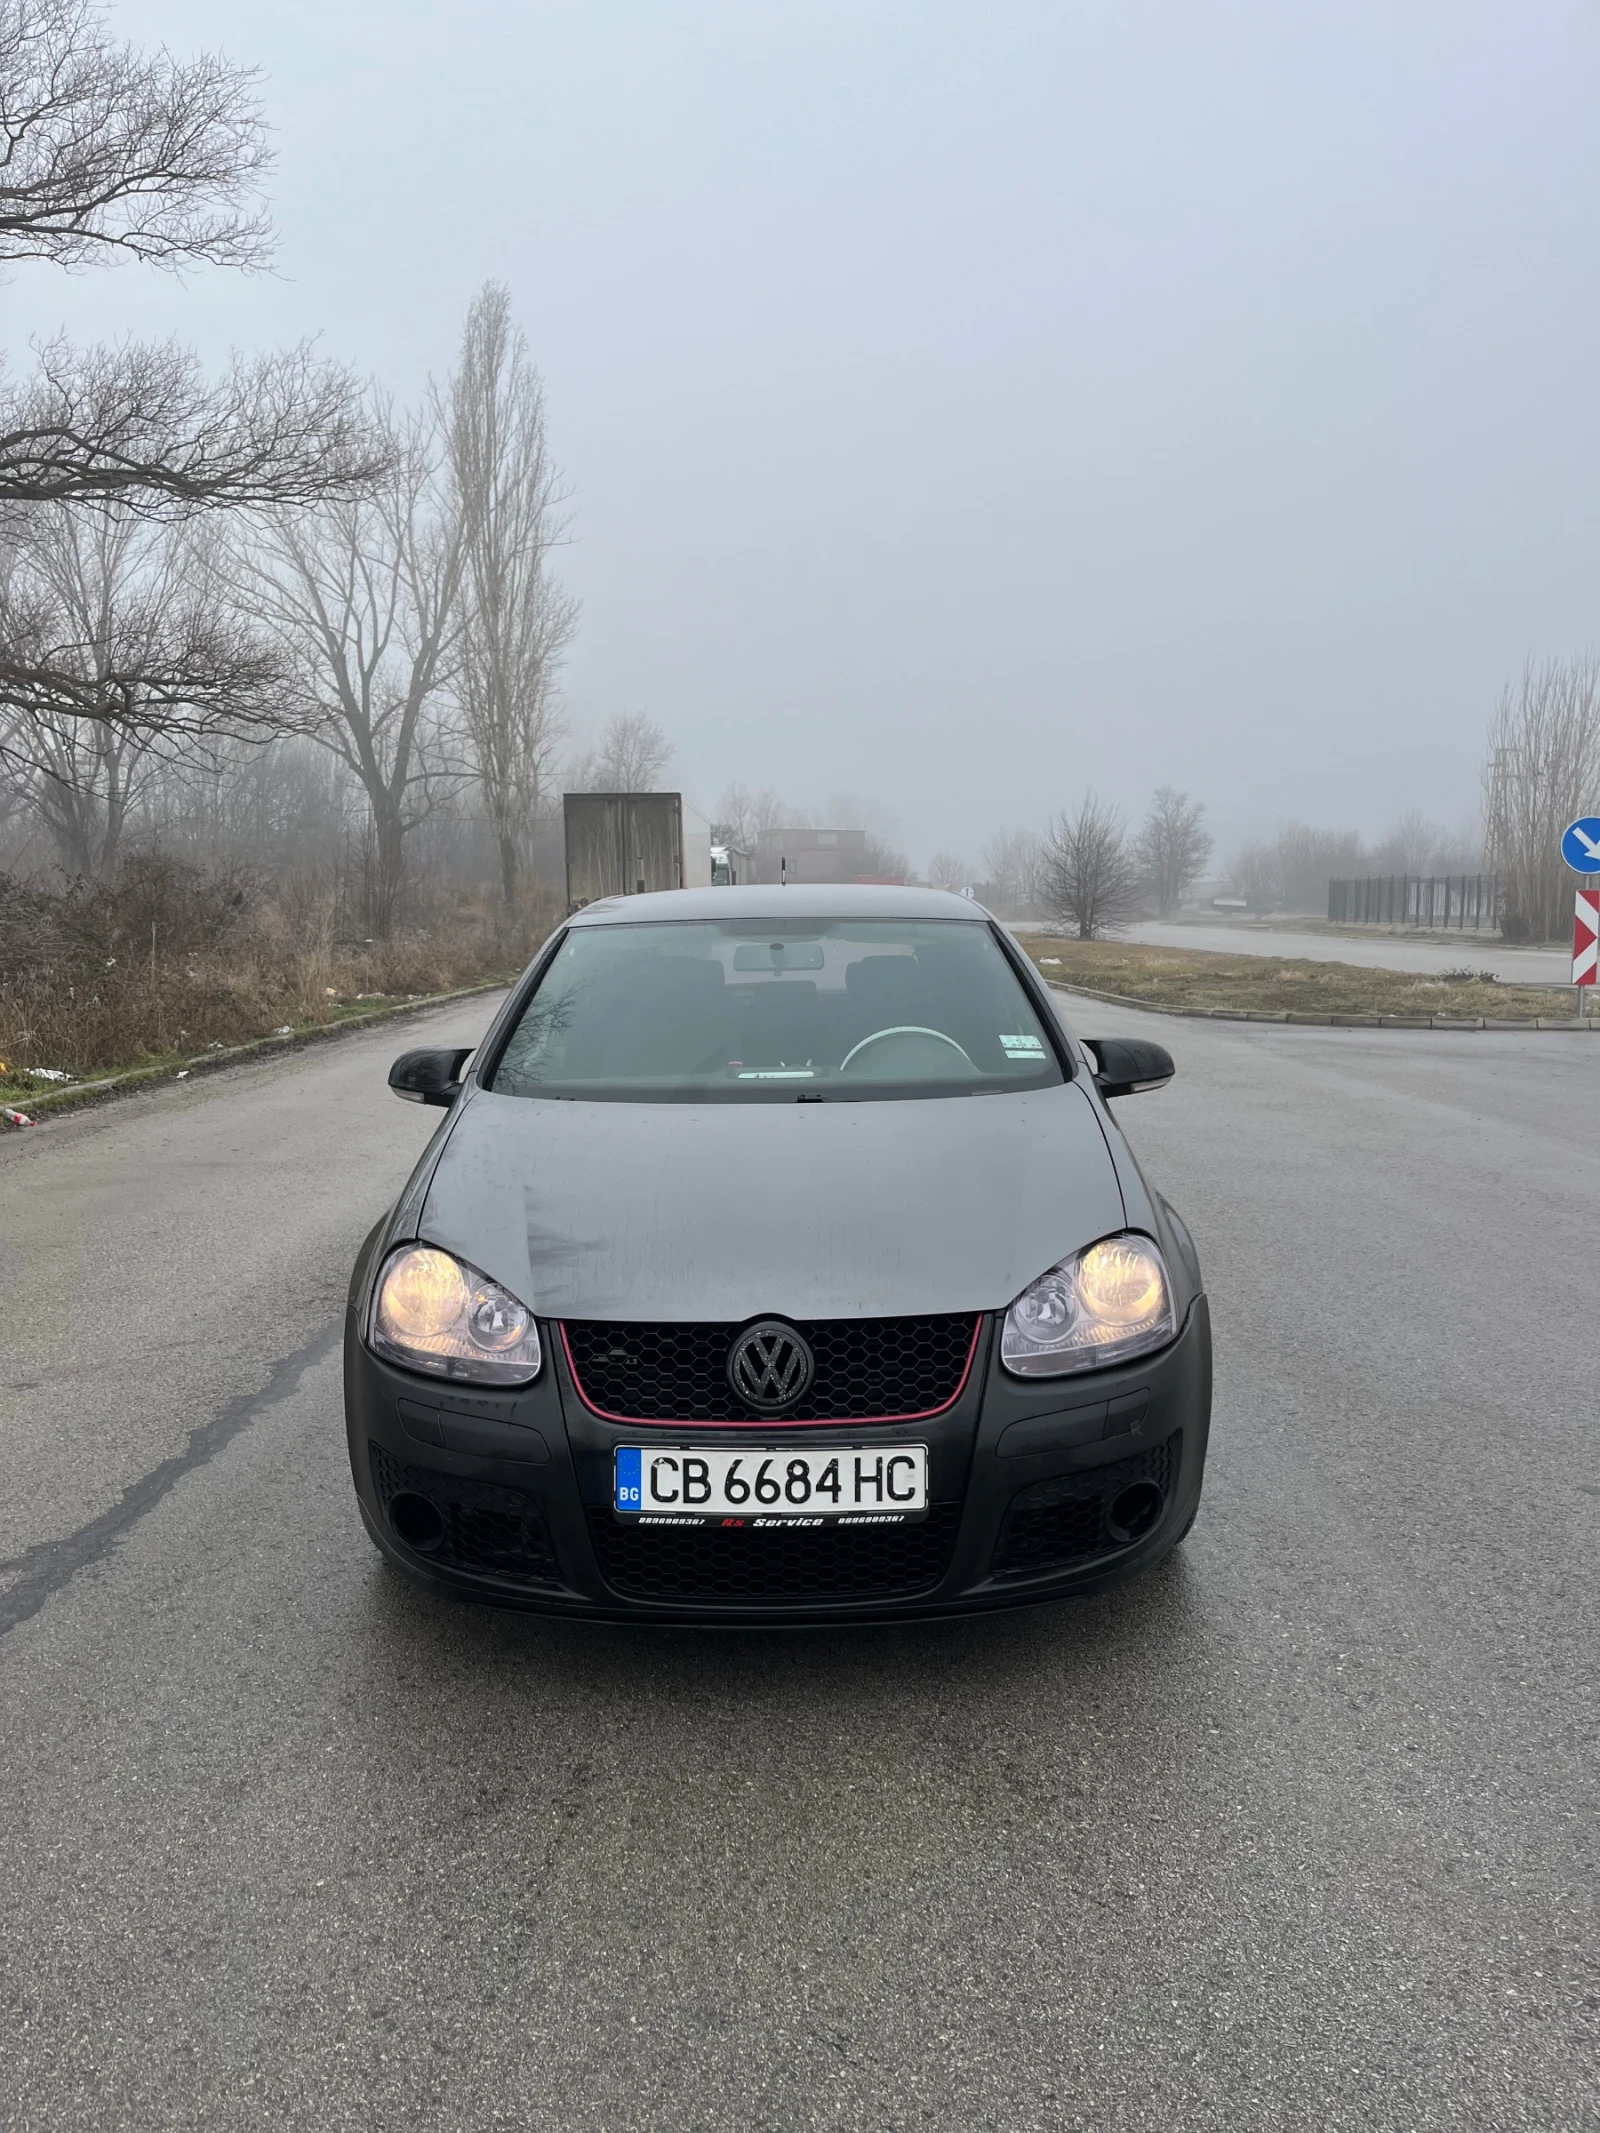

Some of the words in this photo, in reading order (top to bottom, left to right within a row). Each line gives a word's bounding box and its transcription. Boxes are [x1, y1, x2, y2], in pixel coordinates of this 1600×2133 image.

[650, 1456, 712, 1504] CB
[724, 1457, 842, 1504] 6684
[854, 1455, 916, 1503] HC
[619, 1487, 639, 1501] BG
[752, 1517, 824, 1527] Service
